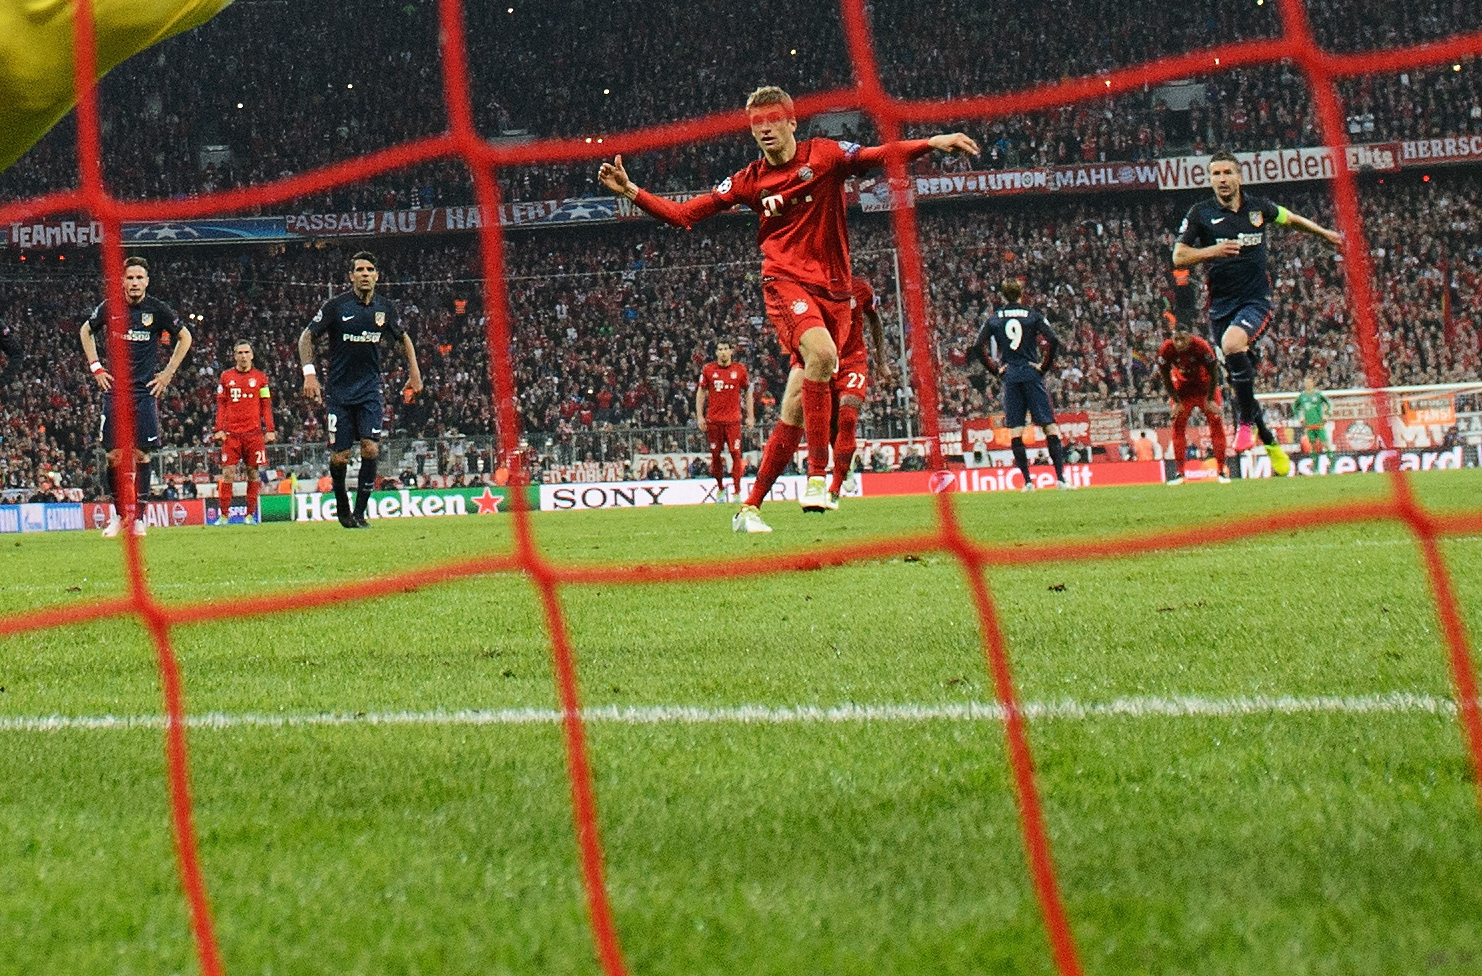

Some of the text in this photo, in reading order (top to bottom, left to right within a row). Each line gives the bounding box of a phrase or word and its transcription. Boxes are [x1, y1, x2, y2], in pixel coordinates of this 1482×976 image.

[1158, 148, 1336, 188] Wienfelden
[286, 211, 368, 232] PASSAU
[1005, 318, 1023, 350] 9
[847, 373, 866, 389] 27
[553, 486, 669, 509] SONY
